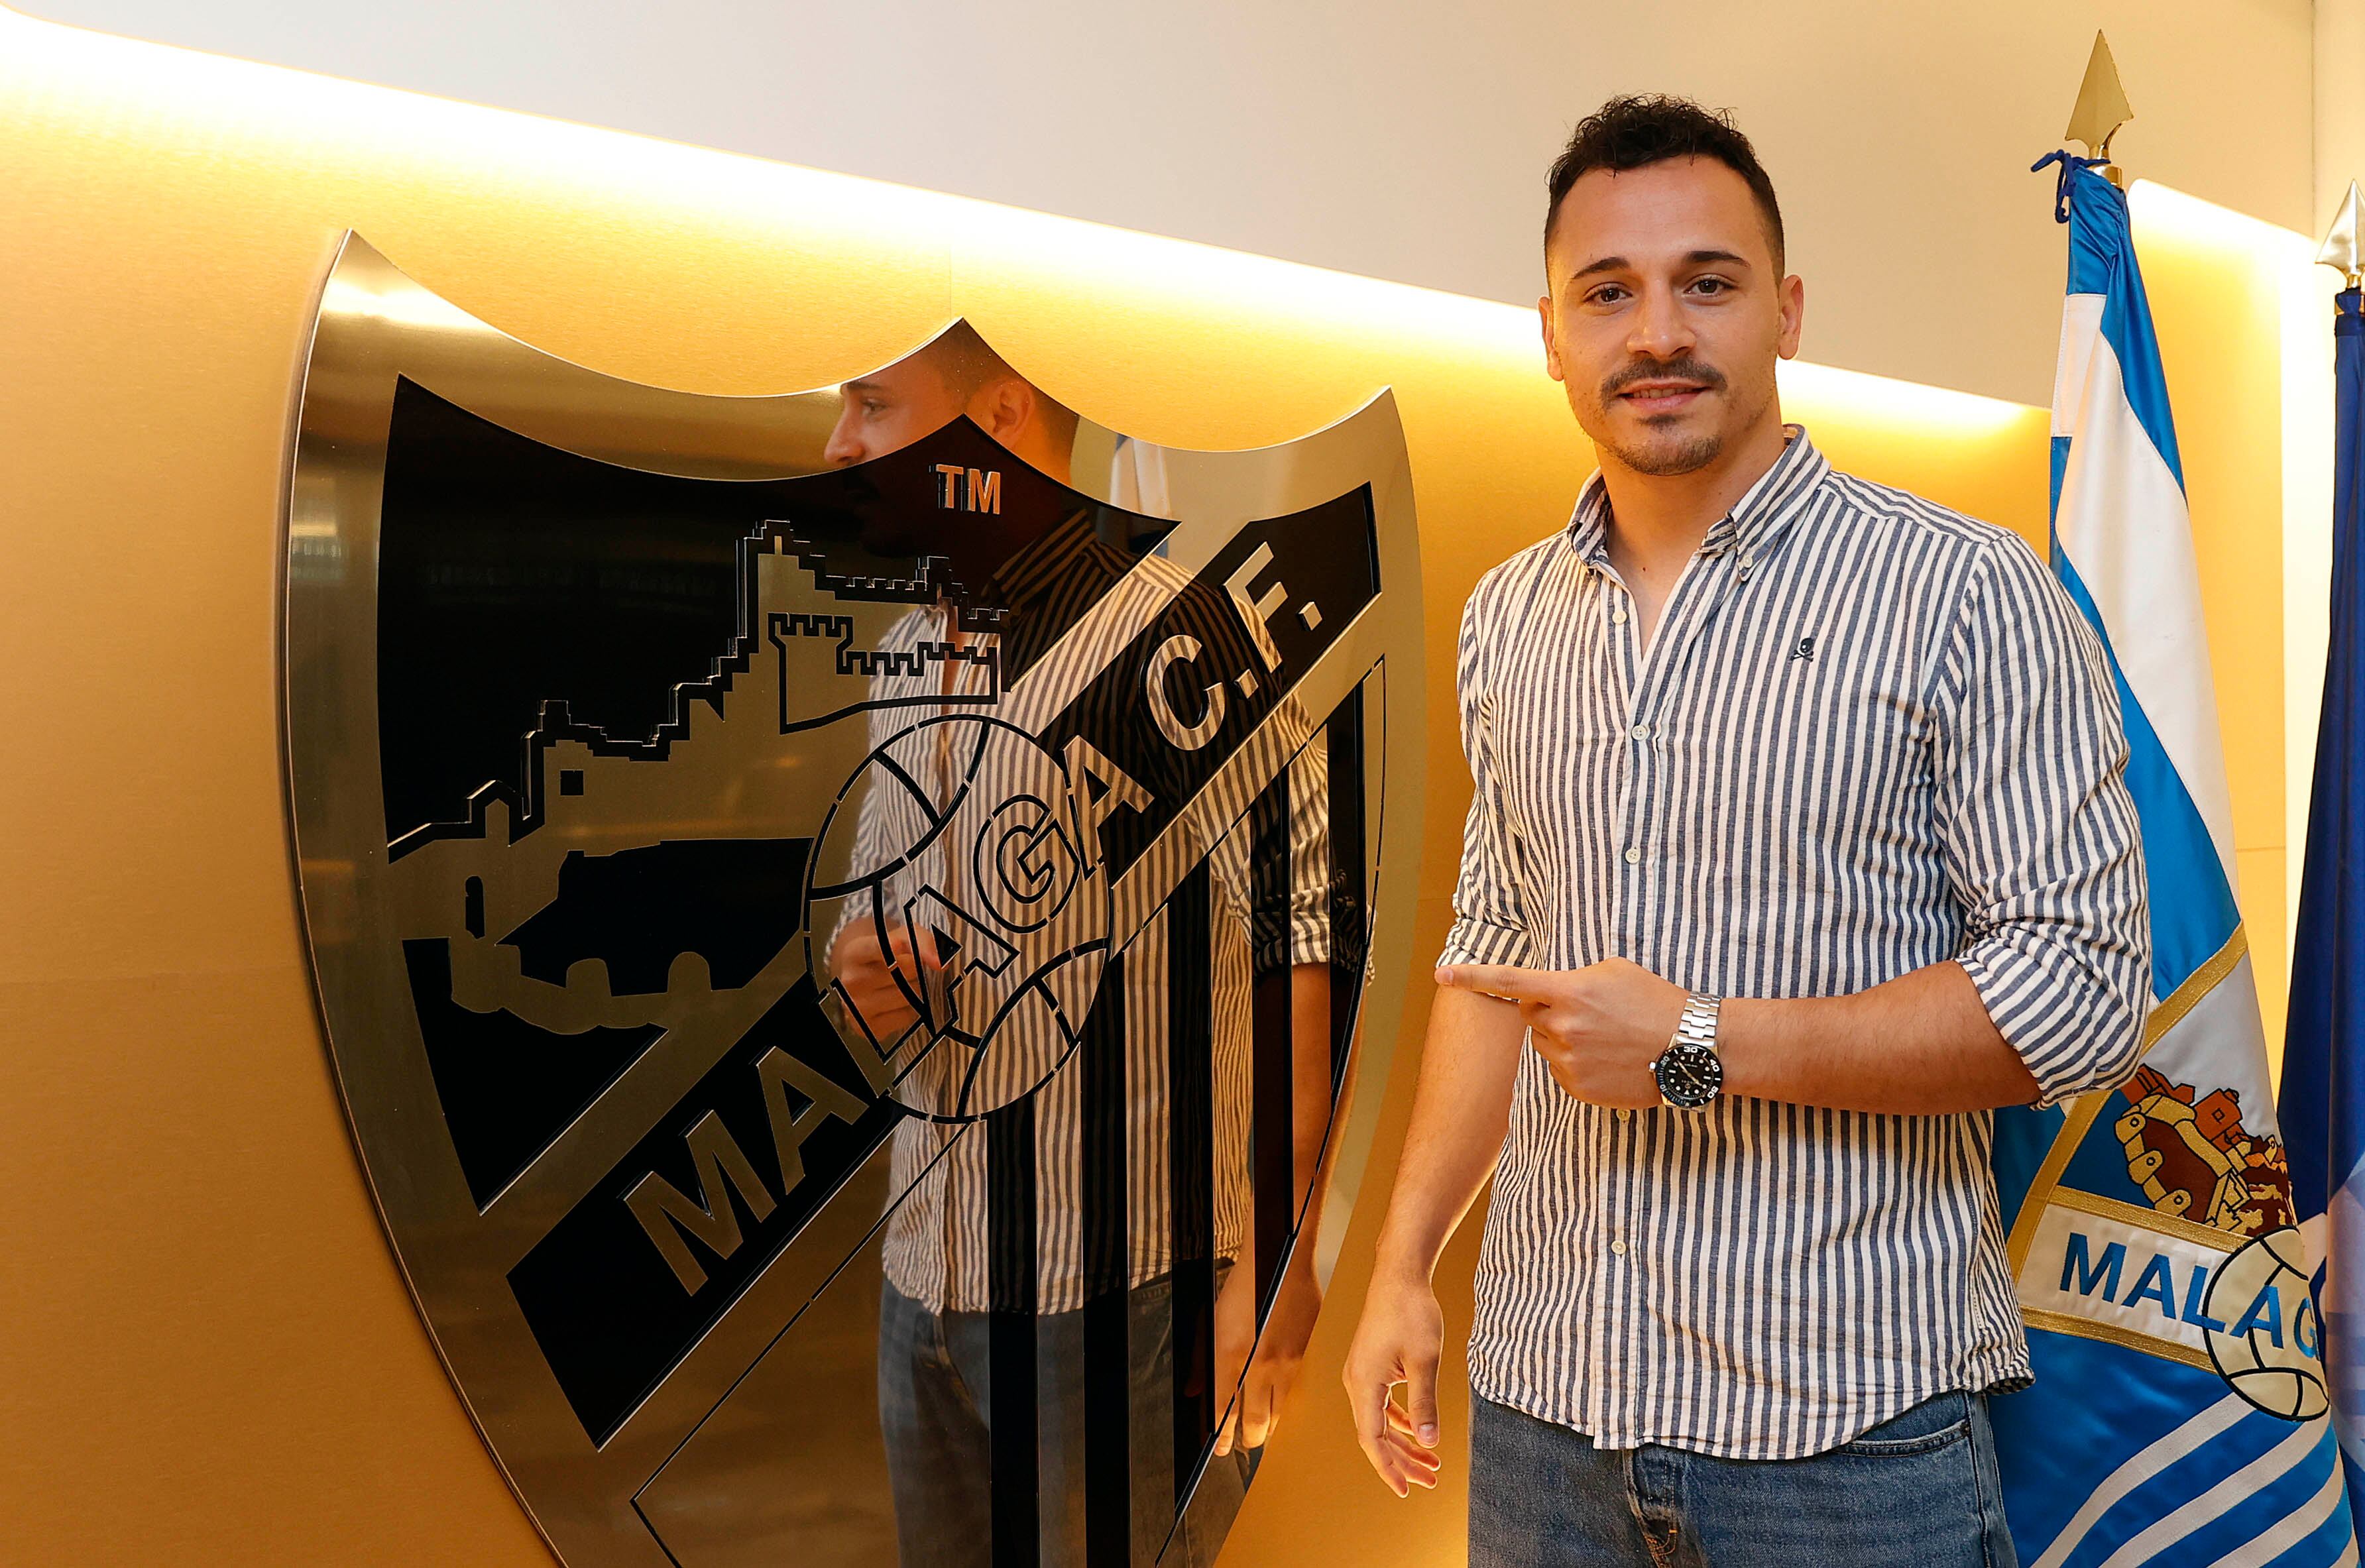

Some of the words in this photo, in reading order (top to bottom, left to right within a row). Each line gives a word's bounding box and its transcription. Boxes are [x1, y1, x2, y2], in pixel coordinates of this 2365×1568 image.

[931, 464, 1001, 514] TM
[619, 735, 1156, 1298] MALAGA
[1140, 541, 1323, 751] C.F.
[1710, 1059, 1719, 1072] 40
[1707, 1086, 1718, 1099] 50
